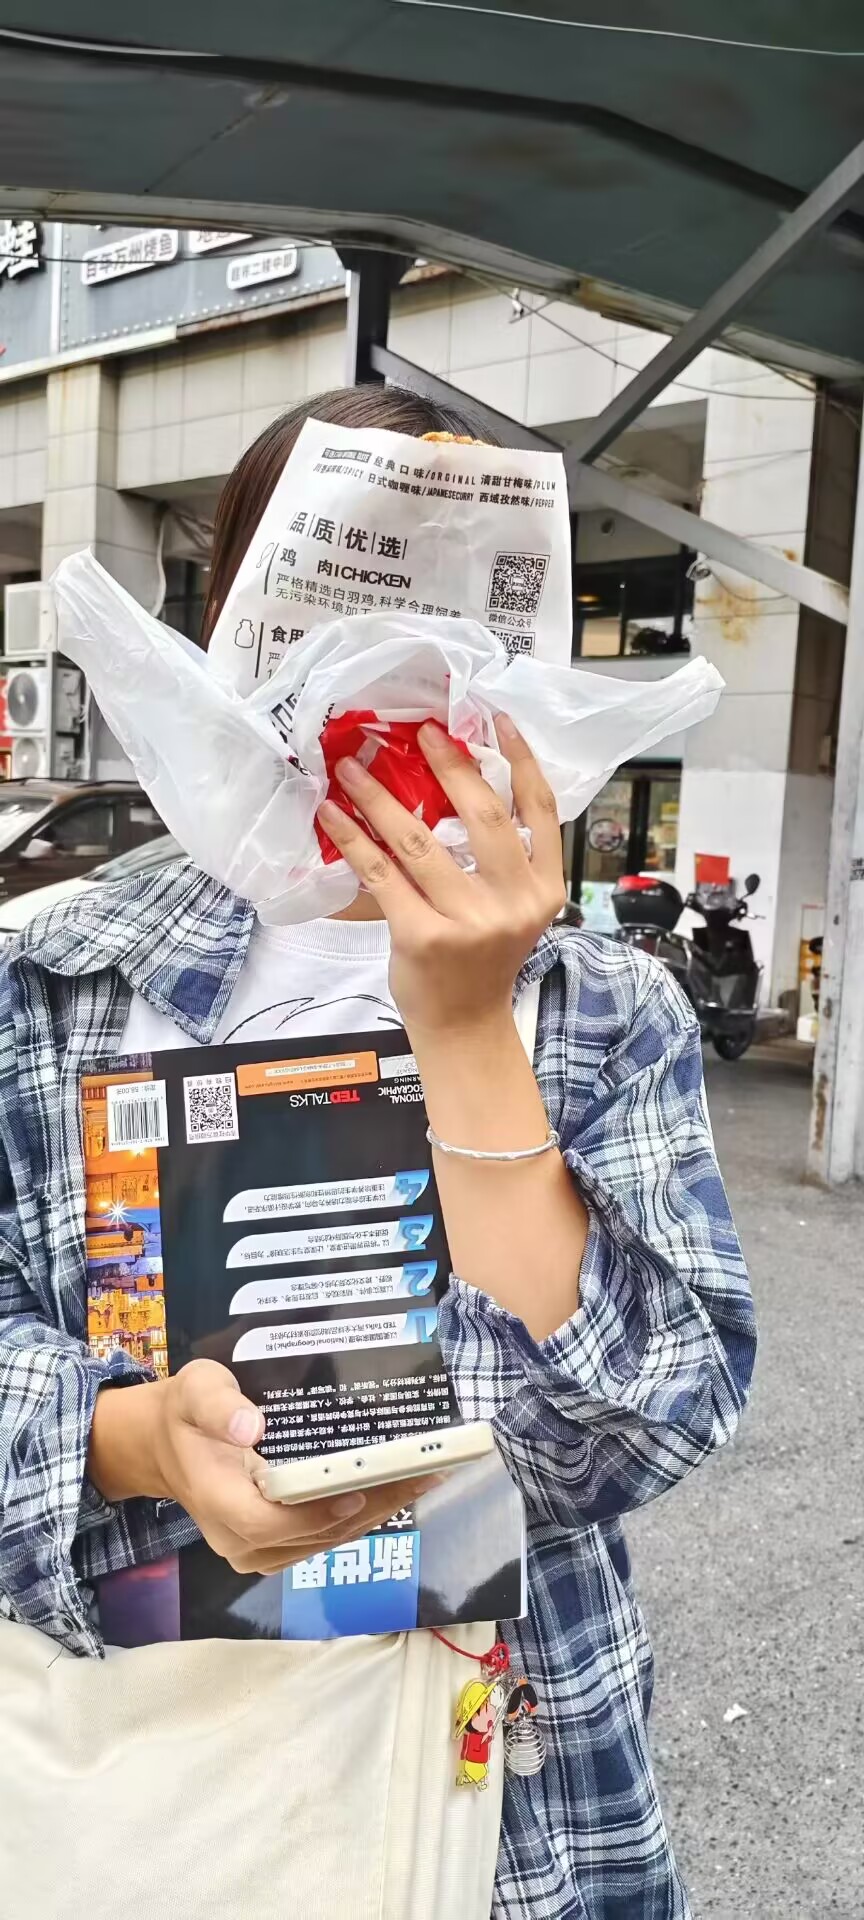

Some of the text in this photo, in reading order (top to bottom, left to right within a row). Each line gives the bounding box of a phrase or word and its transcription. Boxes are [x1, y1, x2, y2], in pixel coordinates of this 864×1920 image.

[481, 474, 556, 490] 清甜甘梅味/PLUM
[488, 613, 532, 628] 微信公众号
[271, 625, 310, 644] 食用
[396, 1179, 422, 1205] 4
[402, 1223, 426, 1250] 3
[407, 1268, 431, 1296] 2
[416, 1316, 432, 1344] 1
[372, 1508, 413, 1529] 交
[292, 1536, 413, 1589] 新世界
